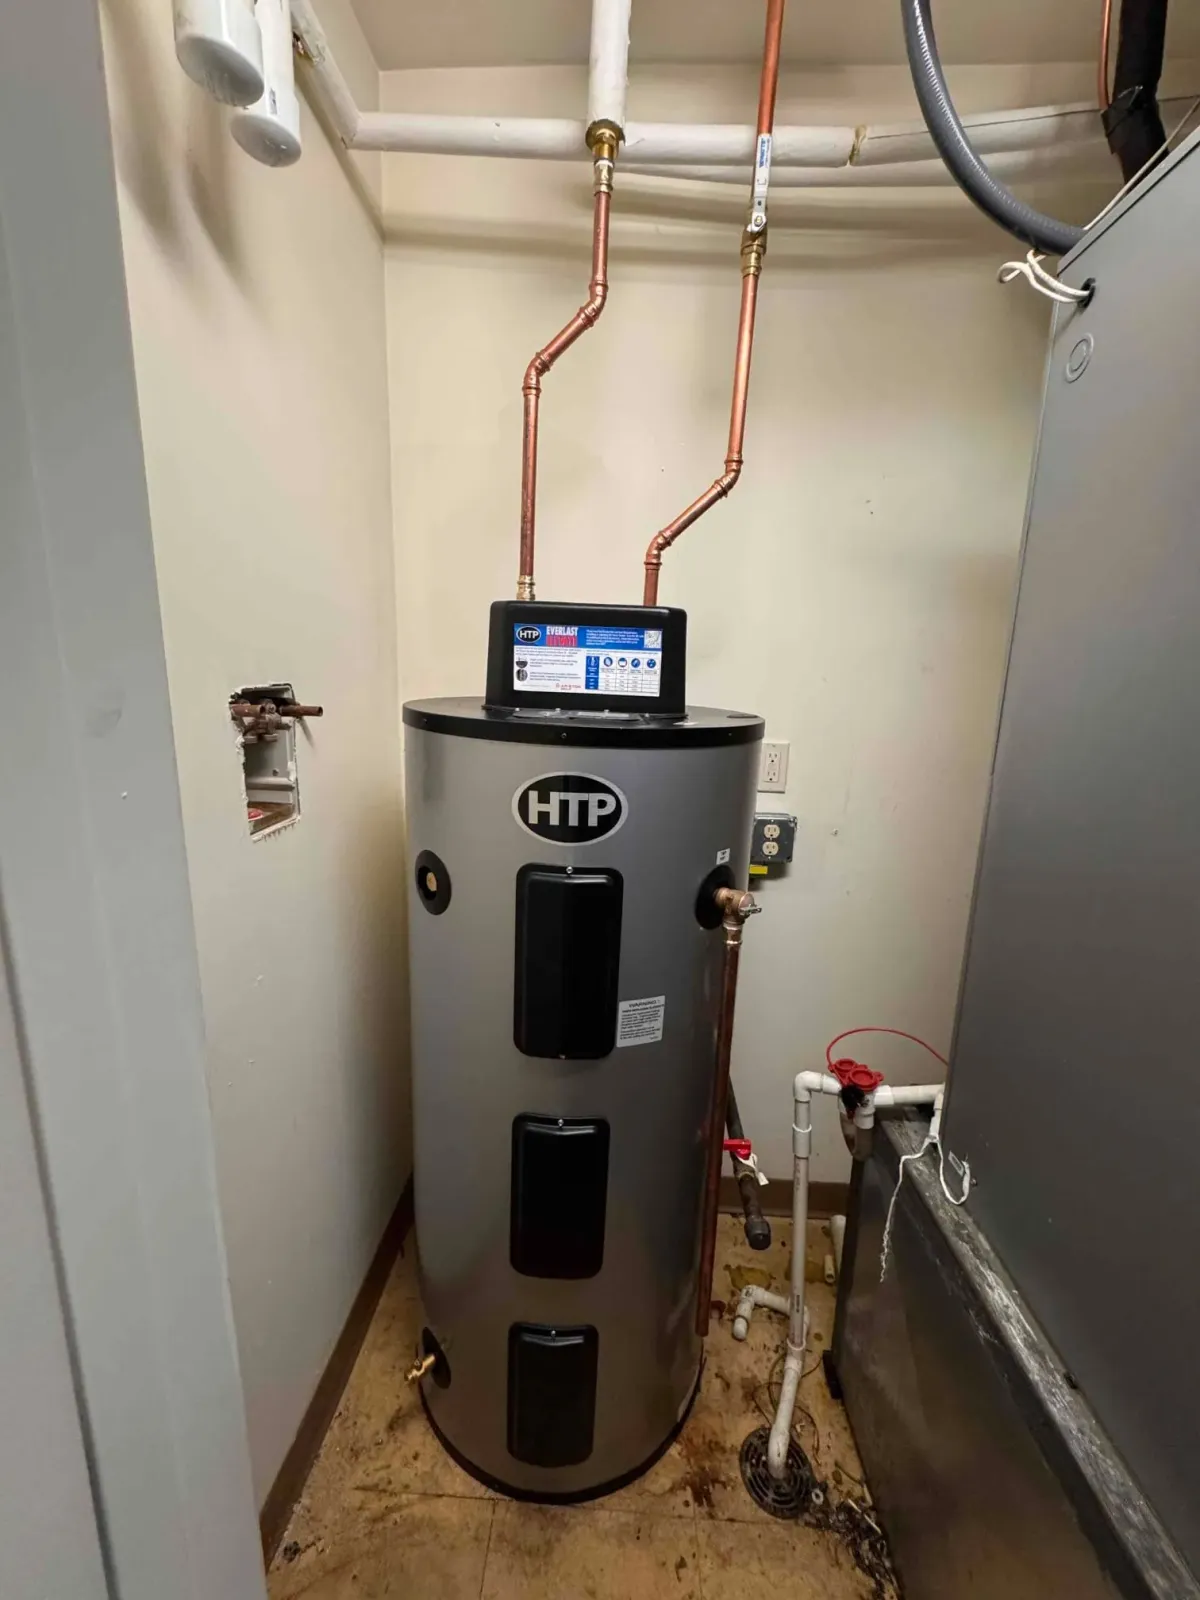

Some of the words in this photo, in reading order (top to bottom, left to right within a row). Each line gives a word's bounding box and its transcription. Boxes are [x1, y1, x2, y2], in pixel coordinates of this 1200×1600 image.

[520, 630, 539, 639] HTP
[546, 626, 578, 636] EVERLAST
[528, 790, 616, 827] HTP
